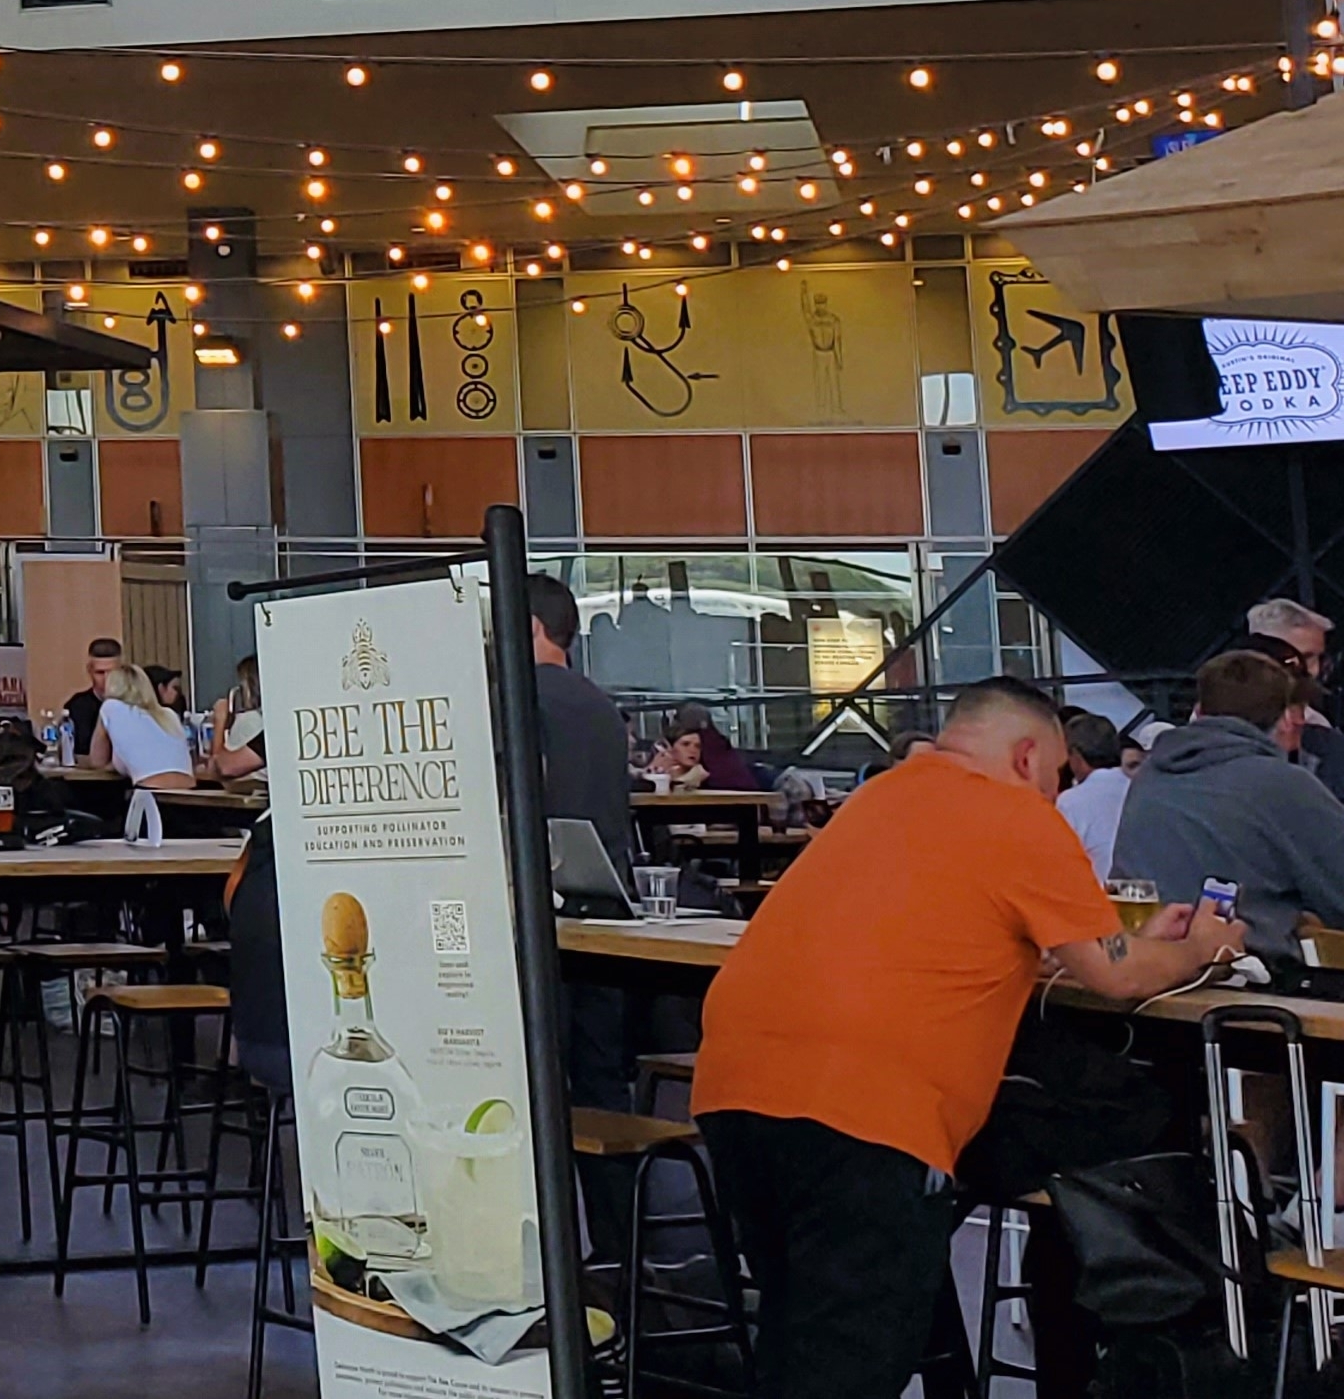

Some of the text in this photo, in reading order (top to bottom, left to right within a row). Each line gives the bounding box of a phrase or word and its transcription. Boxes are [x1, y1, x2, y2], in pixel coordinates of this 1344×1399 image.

[1263, 367, 1321, 392] EDDY
[293, 696, 454, 761] BEE THE
[298, 759, 460, 806] DIFFERENCE
[317, 820, 447, 836] SUPPORTING POLLINATOR
[304, 836, 466, 852] EDUCATION AND PRESERVATION
